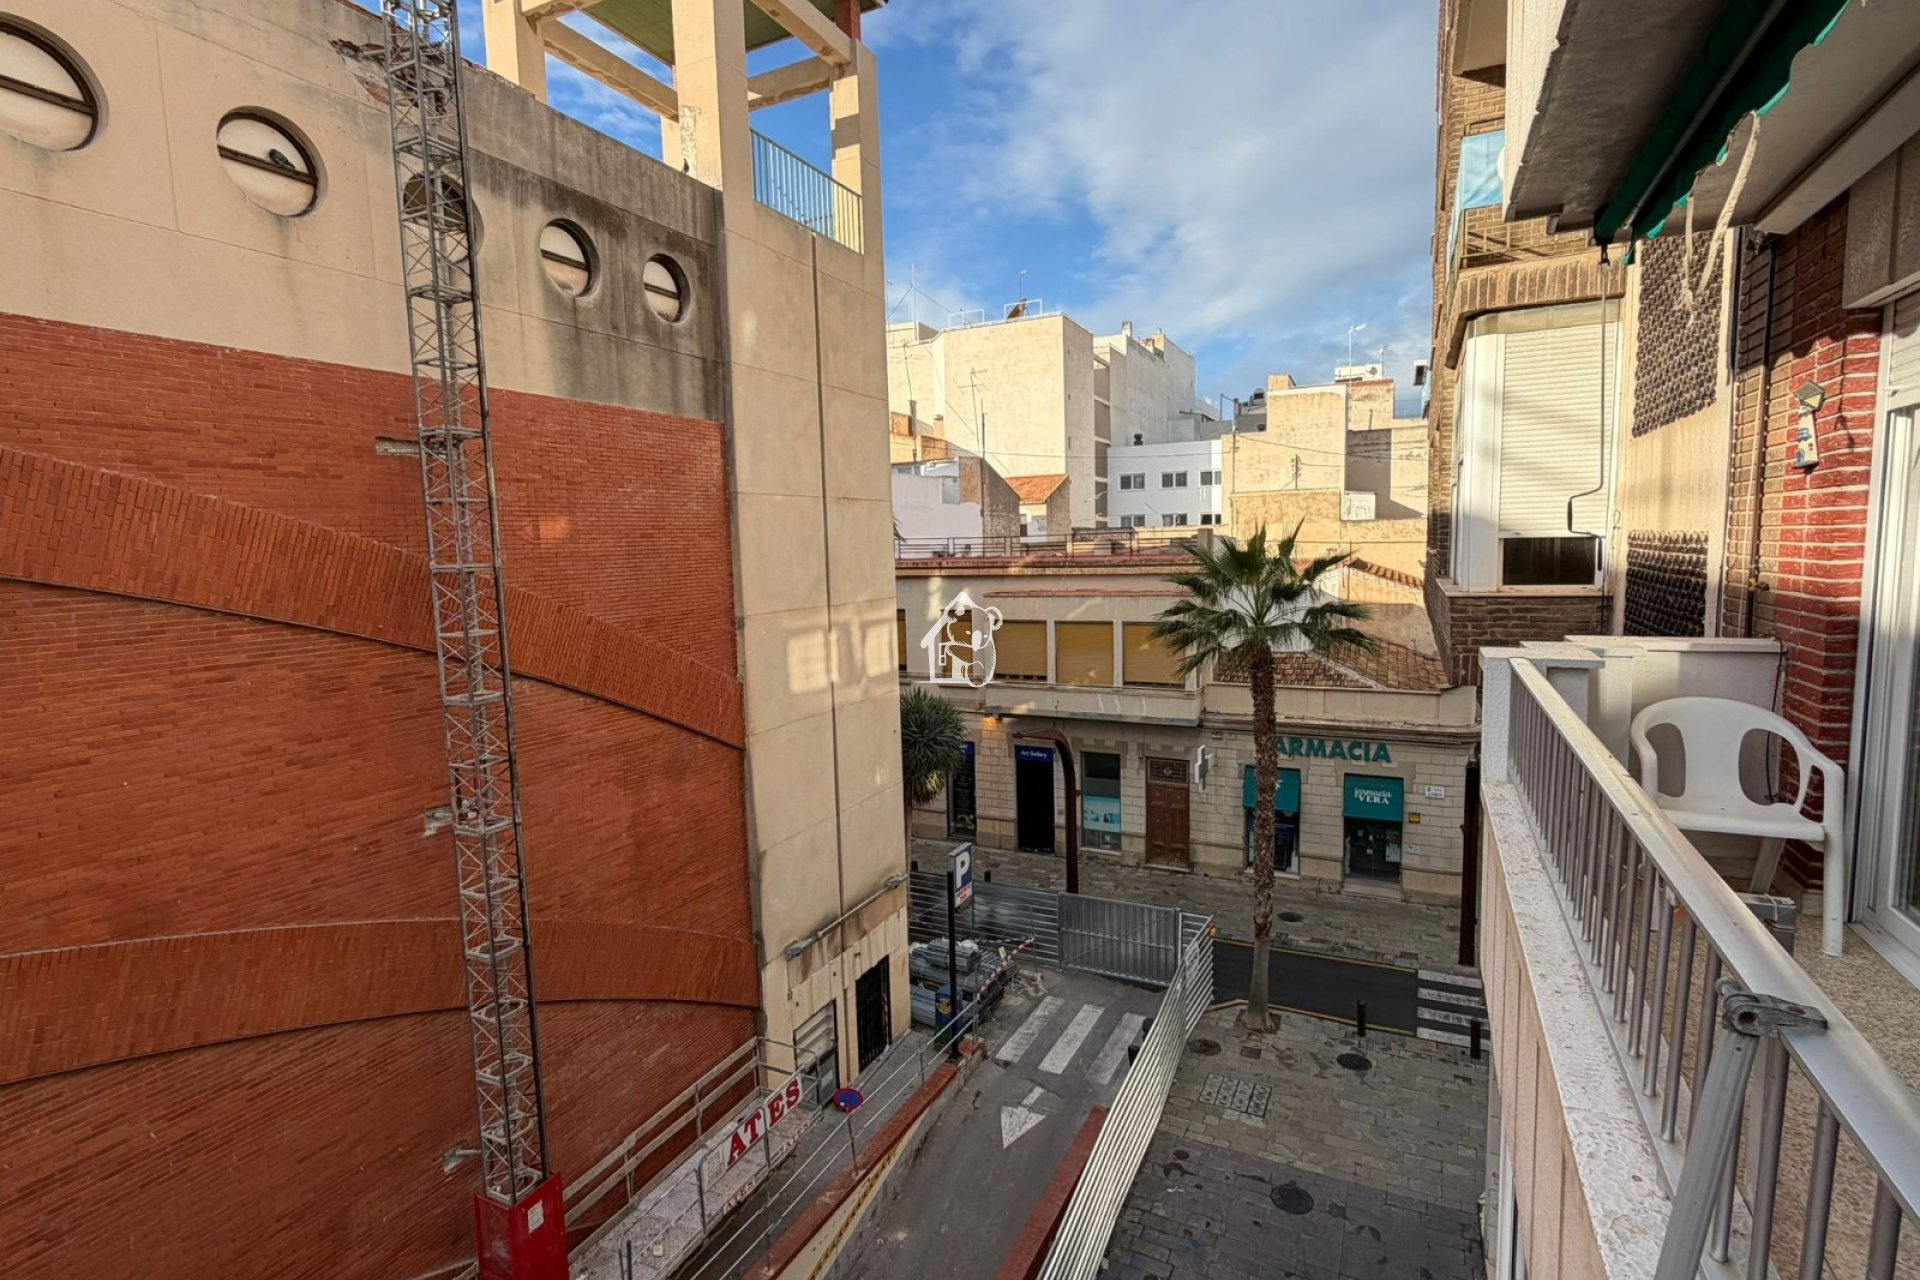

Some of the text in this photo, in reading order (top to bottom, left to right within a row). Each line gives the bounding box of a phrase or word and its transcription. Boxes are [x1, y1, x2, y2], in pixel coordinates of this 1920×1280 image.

[1031, 751, 1048, 759] Gallery
[1276, 737, 1392, 763] ARMACIA
[1358, 795, 1389, 804] VERA
[956, 851, 970, 889] P
[727, 1079, 800, 1167] ATES
